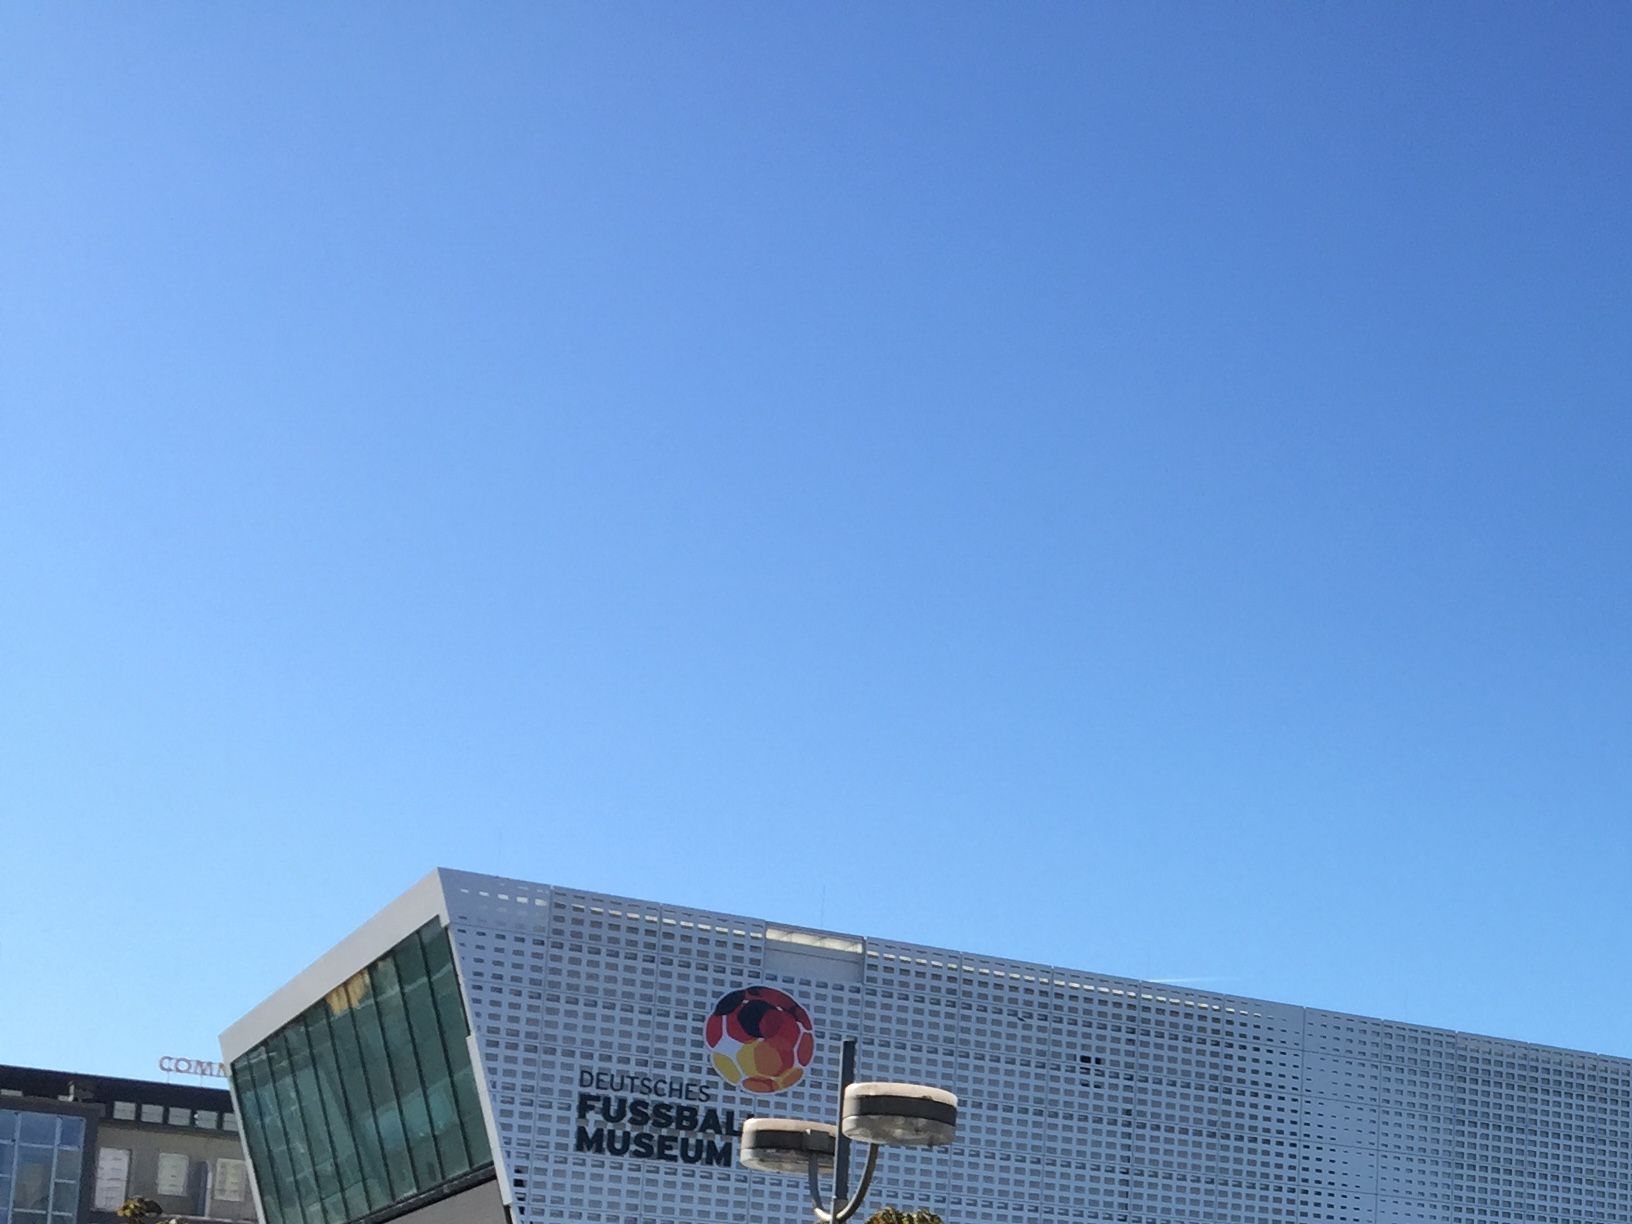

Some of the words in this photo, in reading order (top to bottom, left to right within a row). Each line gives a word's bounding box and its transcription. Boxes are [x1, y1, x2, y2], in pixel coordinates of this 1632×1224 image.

[579, 1070, 711, 1102] DEUTSCHES
[577, 1093, 754, 1137] FUSSBAL
[575, 1126, 732, 1167] MUSEUM
